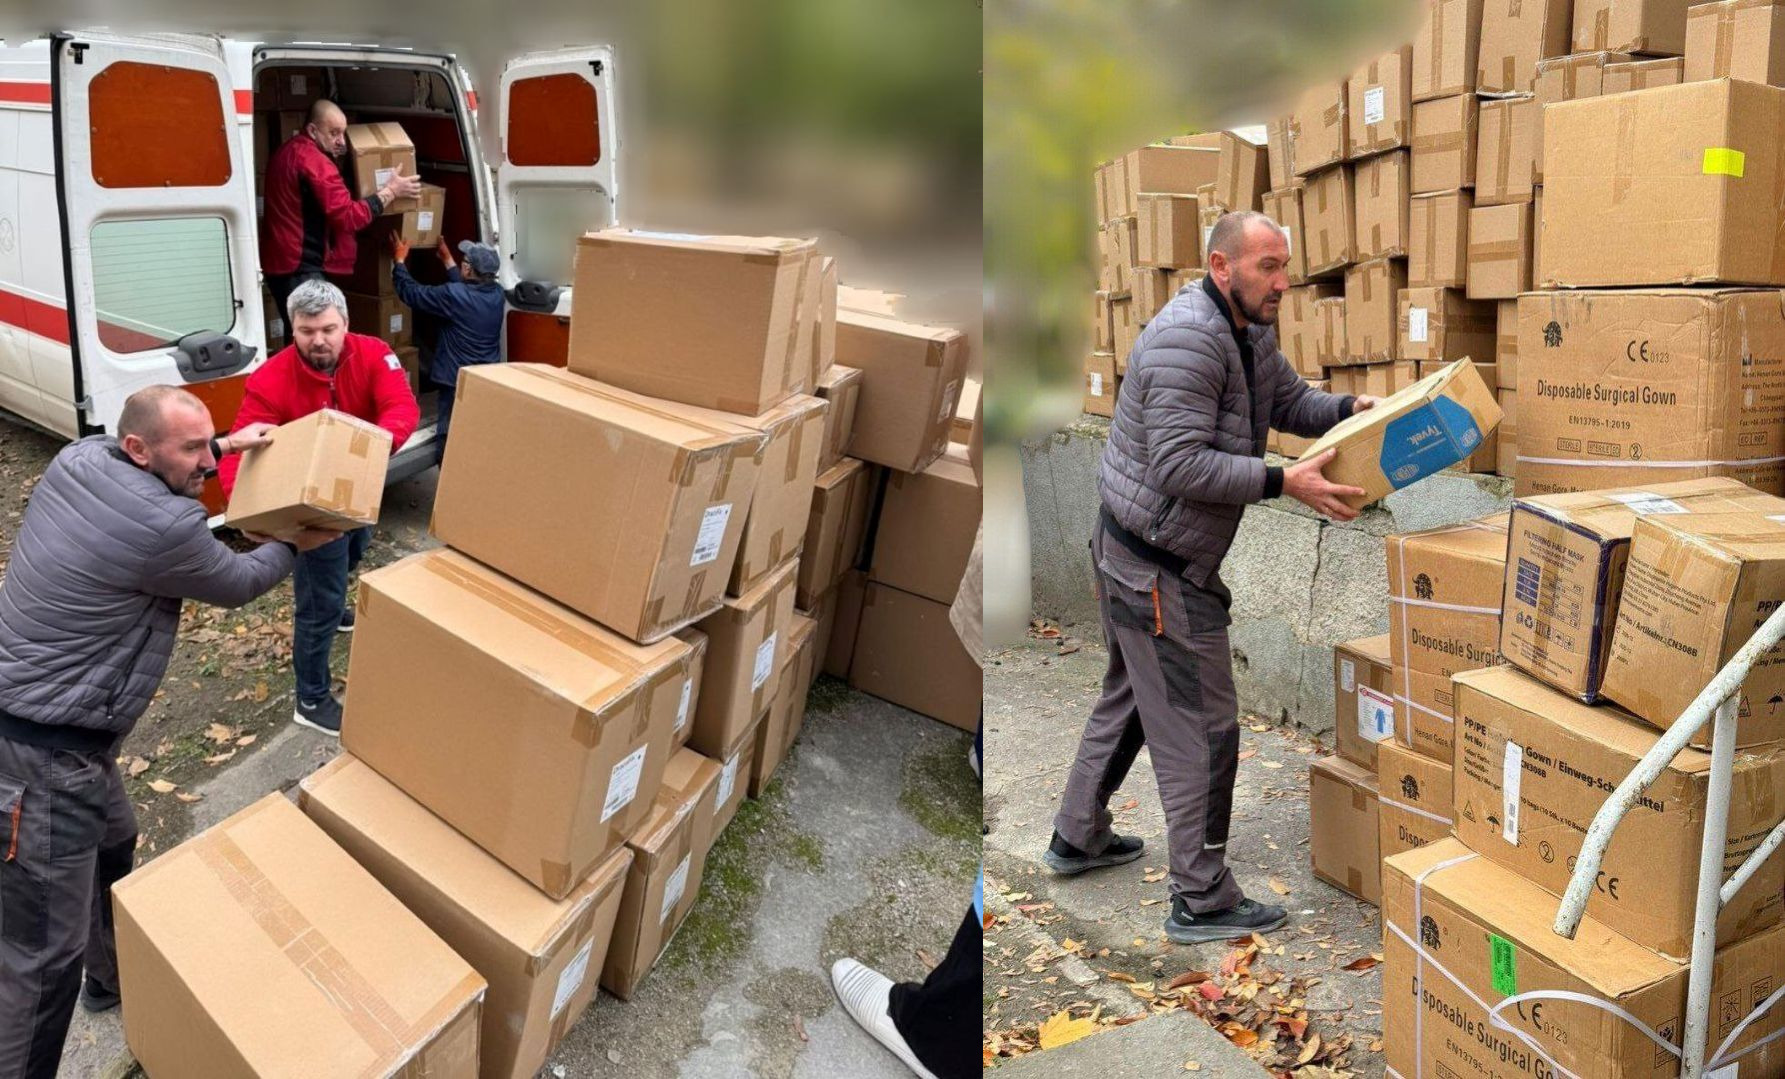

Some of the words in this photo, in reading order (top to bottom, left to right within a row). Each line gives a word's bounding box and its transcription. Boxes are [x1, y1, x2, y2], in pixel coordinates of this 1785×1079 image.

[1650, 352, 1670, 363] 0123
[1537, 379, 1592, 400] Disposable
[1594, 383, 1639, 406] Surgical
[1642, 386, 1677, 405] Gown
[1412, 628, 1464, 658] Disposable
[1466, 643, 1507, 668] Surgica
[1668, 637, 1698, 658] CN308B
[1464, 715, 1487, 736] PP/PE
[1526, 745, 1552, 767] Gown
[1412, 975, 1474, 1036] Dsposable
[1477, 1022, 1531, 1073] Surgical
[1543, 1021, 1568, 1045] 0123
[1447, 1039, 1502, 1079] EN13795-1:
